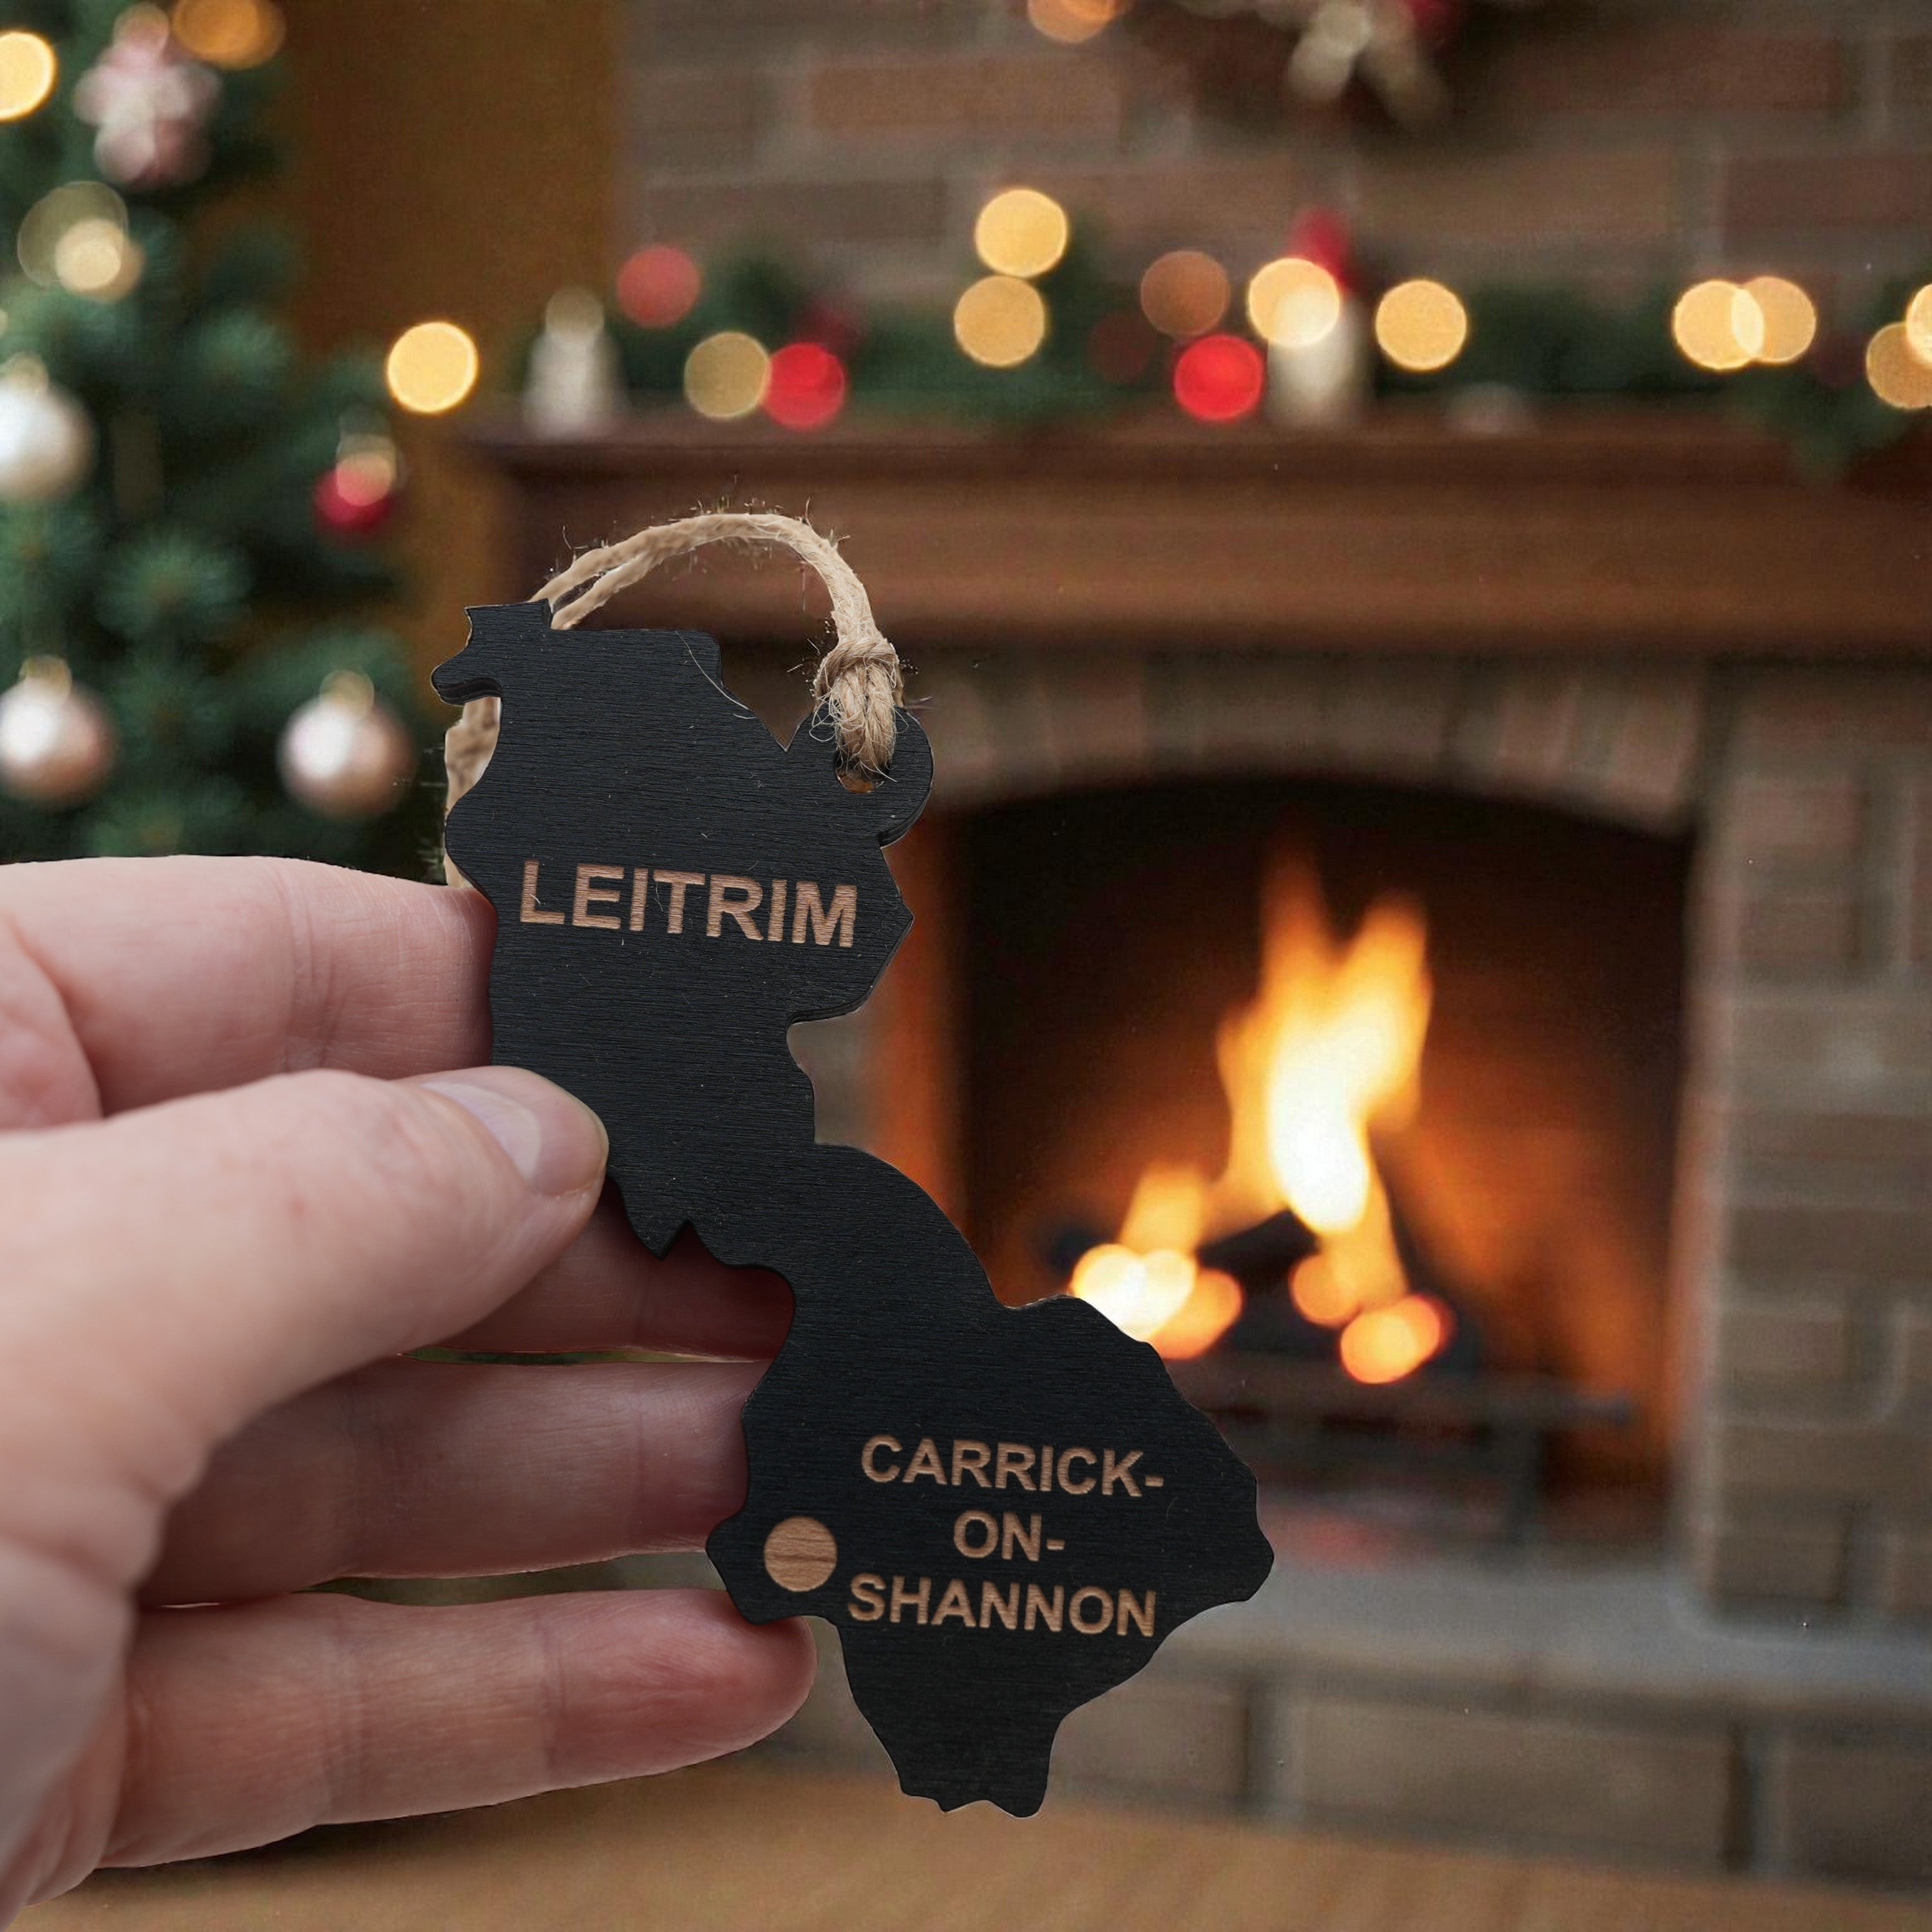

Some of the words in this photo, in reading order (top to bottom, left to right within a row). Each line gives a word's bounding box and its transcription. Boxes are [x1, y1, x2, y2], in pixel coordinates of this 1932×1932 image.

[520, 860, 858, 948] LEITRIM
[861, 1435, 1164, 1497] CARRICK-
[952, 1510, 1065, 1562] ON-
[848, 1573, 1157, 1638] SHANNON
